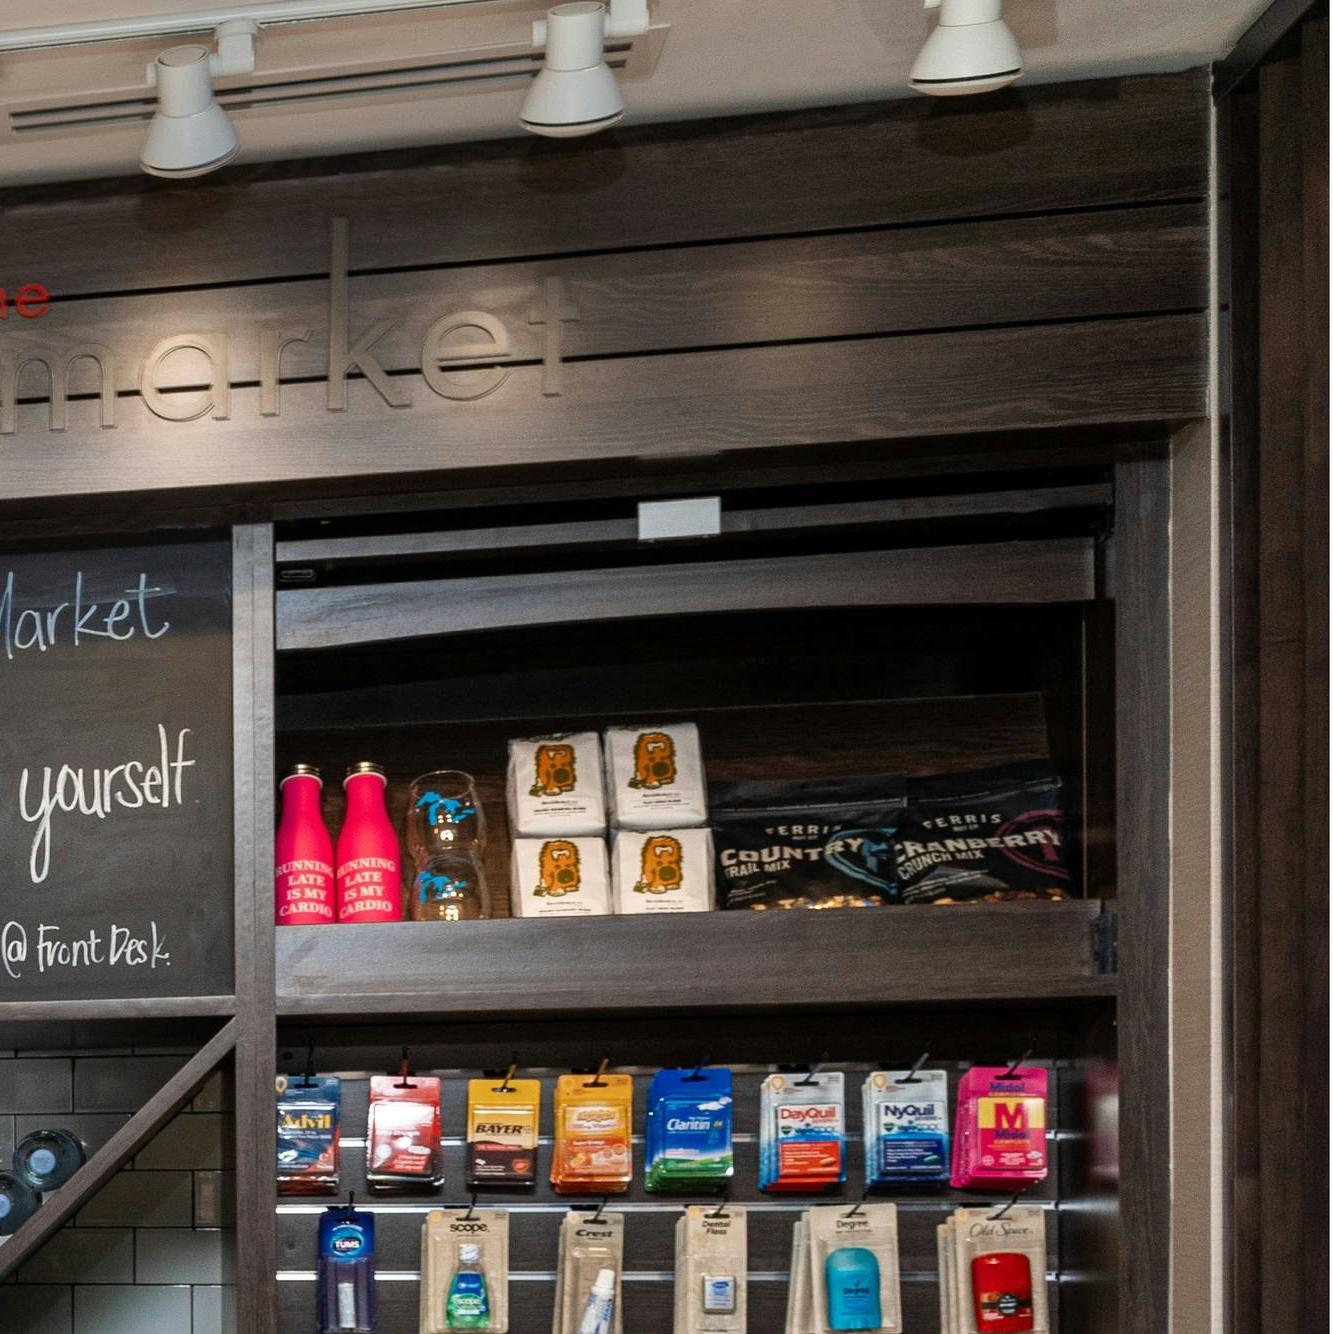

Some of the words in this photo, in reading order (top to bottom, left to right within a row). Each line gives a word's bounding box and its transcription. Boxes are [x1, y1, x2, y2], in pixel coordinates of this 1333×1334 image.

[0, 216, 581, 435] market
[19, 723, 196, 884] yourself
[720, 837, 864, 868] COUNTRY
[894, 829, 1061, 863] CRANBERRY
[897, 851, 952, 881] CRUNCH
[954, 849, 984, 861] MIX
[288, 873, 326, 886] LATE
[345, 871, 383, 887] LATE
[286, 888, 301, 900] IS
[304, 888, 327, 901] MY
[344, 889, 357, 902] IS
[360, 886, 384, 897] MY
[279, 902, 332, 918] CARDIO
[339, 900, 393, 919] CARDIO
[1, 921, 29, 979] @
[36, 923, 103, 973] Front
[780, 1107, 837, 1122] DayQuil
[884, 1104, 935, 1119] NyQuil
[475, 1123, 524, 1135] BAYER
[666, 1116, 710, 1131] Claritin
[449, 1222, 489, 1234] scope
[575, 1229, 613, 1238] Crest
[836, 1219, 869, 1232] Degree
